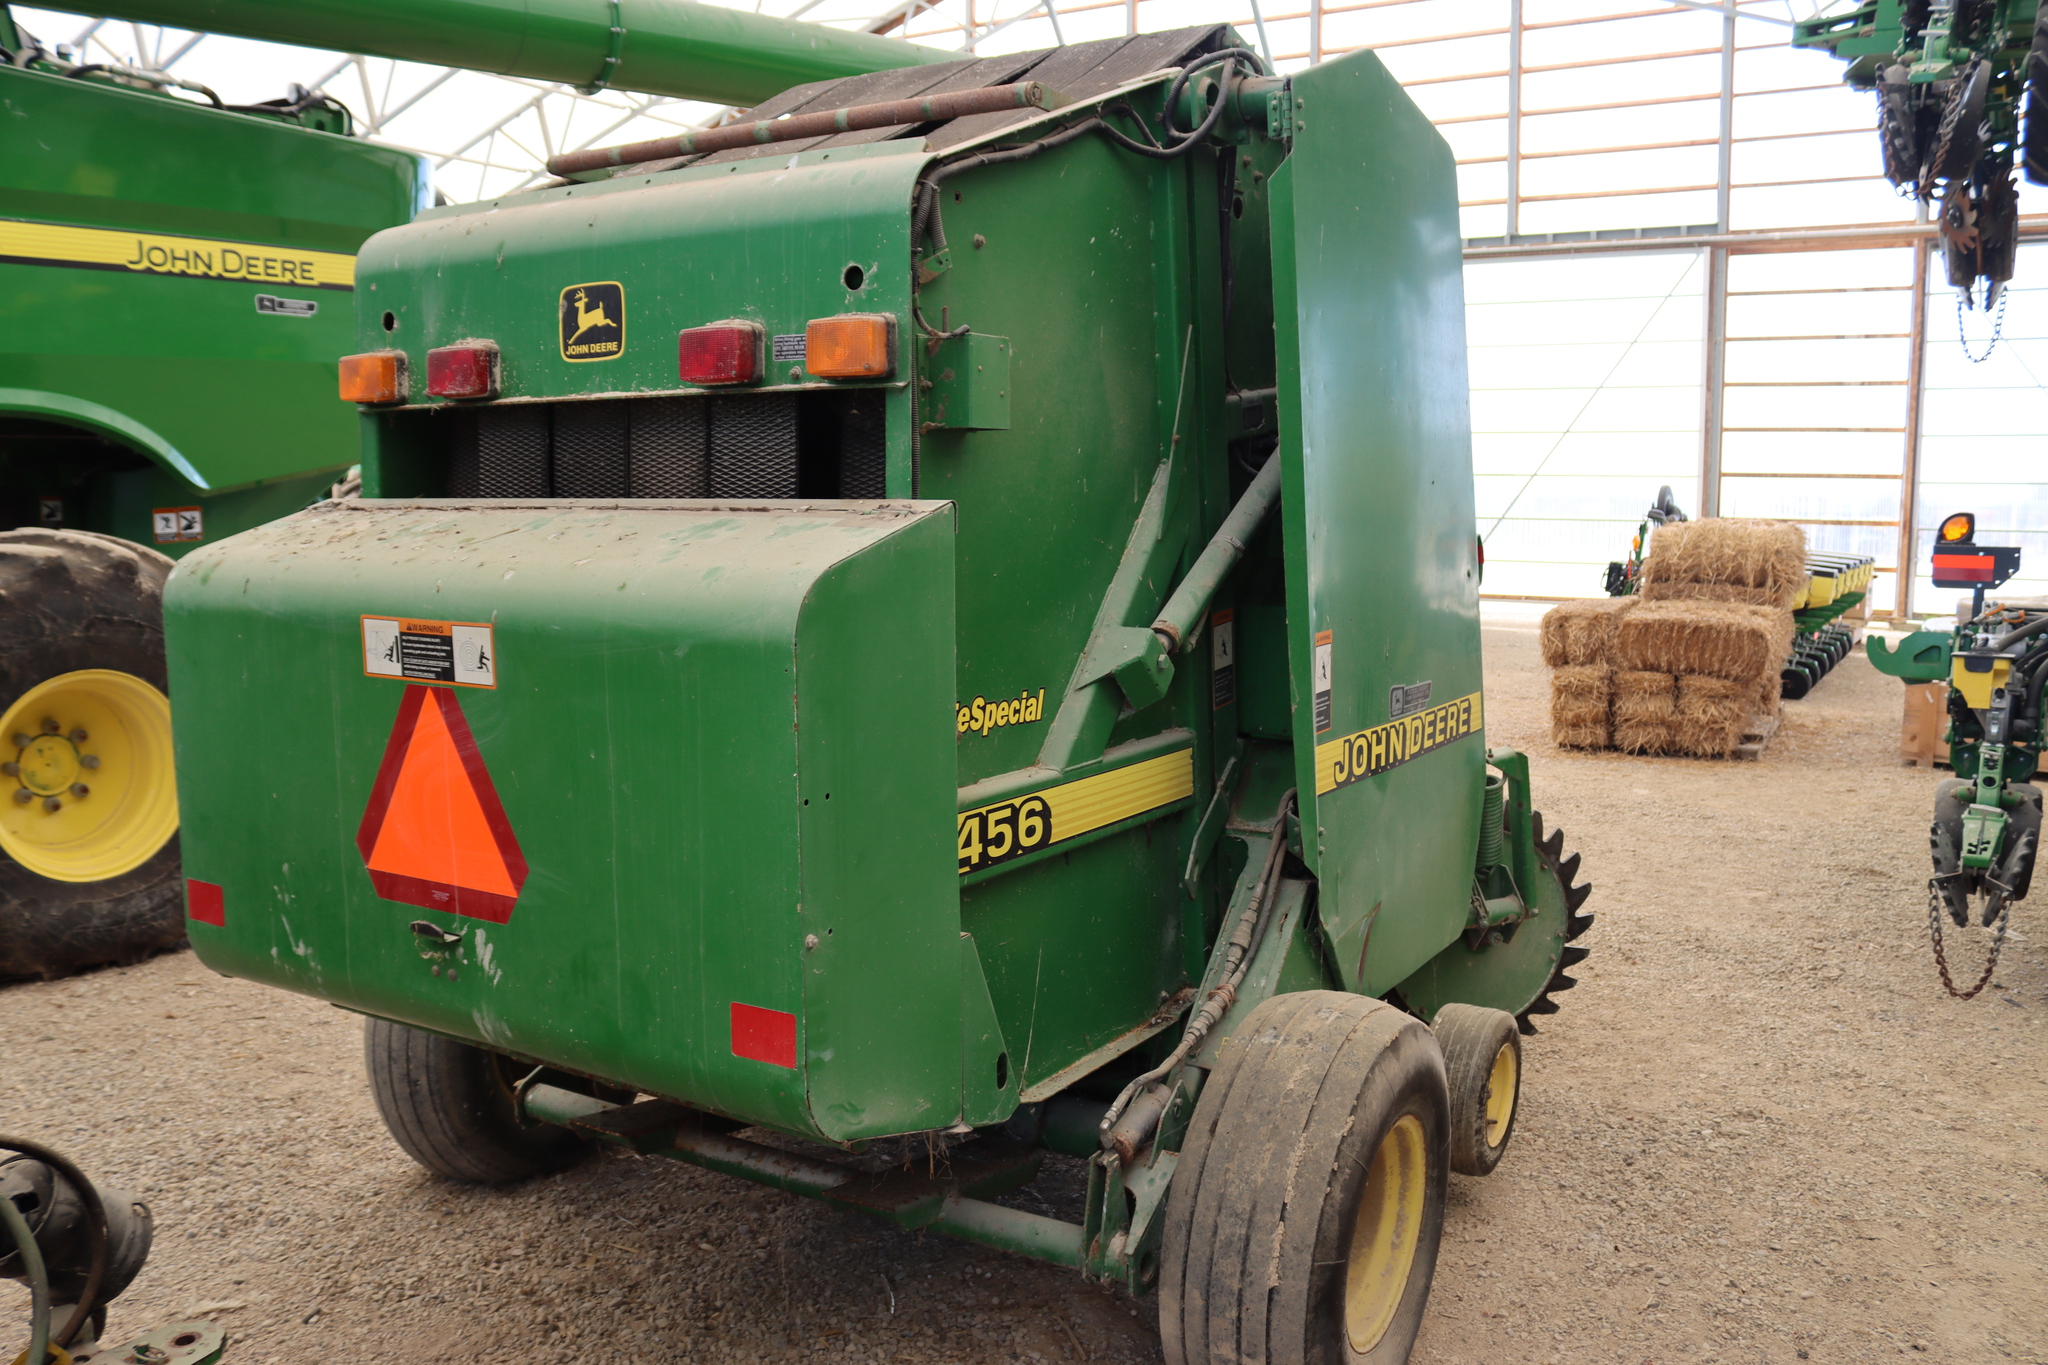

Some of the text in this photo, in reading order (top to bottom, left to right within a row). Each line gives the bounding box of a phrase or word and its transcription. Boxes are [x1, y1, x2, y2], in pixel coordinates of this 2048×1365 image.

[127, 240, 315, 281] JOHN DEERE
[566, 341, 619, 356] JOHN DEERE
[411, 623, 444, 634] WARNING
[1334, 699, 1470, 783] JOHN DEERE
[957, 799, 1044, 865] 456
